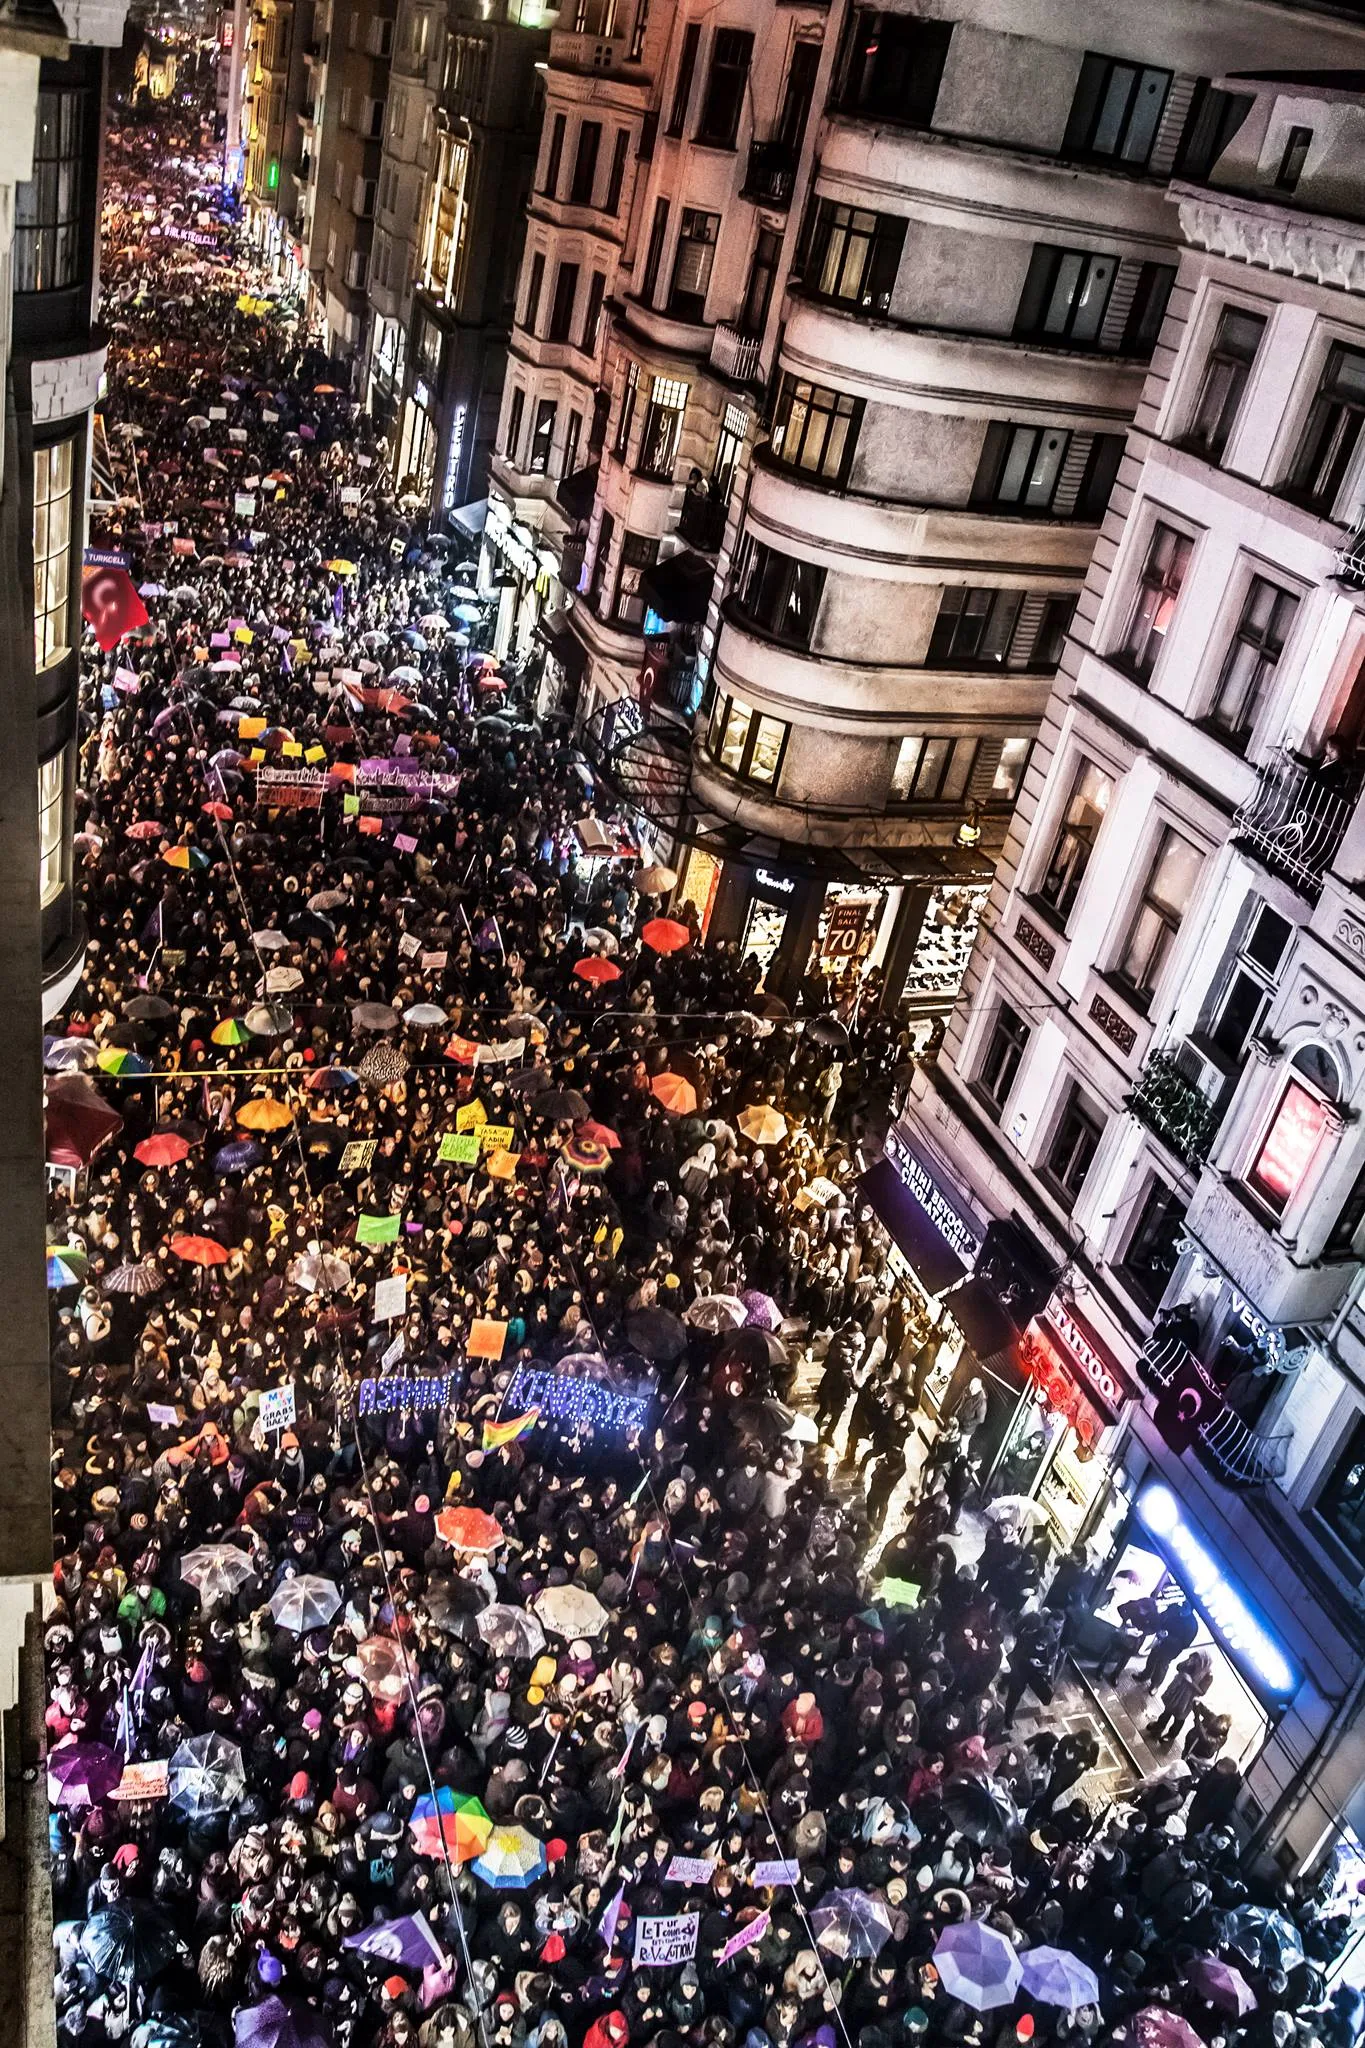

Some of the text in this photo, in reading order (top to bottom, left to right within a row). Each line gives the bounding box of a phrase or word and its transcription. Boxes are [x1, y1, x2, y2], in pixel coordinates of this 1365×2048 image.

[89, 553, 126, 565] TURKCELL
[838, 909, 862, 917] FINAL
[837, 918, 857, 926] SALE
[829, 929, 857, 952] 70
[1054, 1305, 1115, 1398] TATTOO
[268, 1391, 284, 1401] MY
[262, 1406, 294, 1421] GRABS
[266, 1414, 290, 1428] BACK
